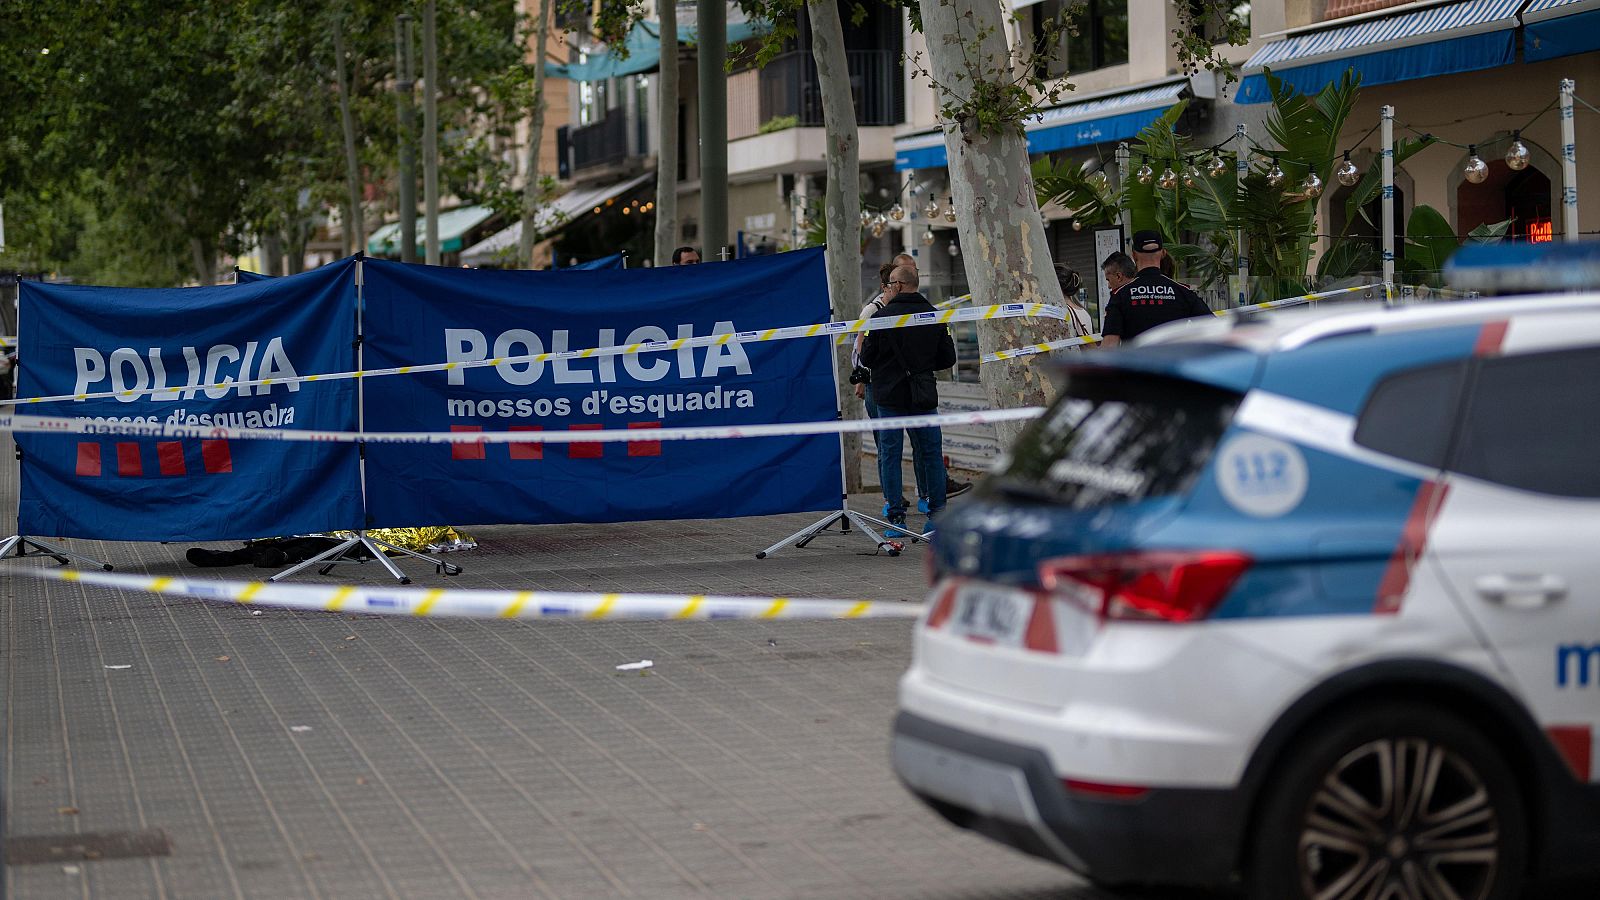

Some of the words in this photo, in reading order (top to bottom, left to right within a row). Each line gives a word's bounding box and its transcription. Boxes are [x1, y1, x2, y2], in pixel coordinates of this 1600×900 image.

[1130, 285, 1175, 295] POLICIA
[73, 336, 300, 403] POLICIA
[445, 320, 753, 386] POLICIA
[447, 396, 571, 418] mossos
[1232, 450, 1288, 484] 112
